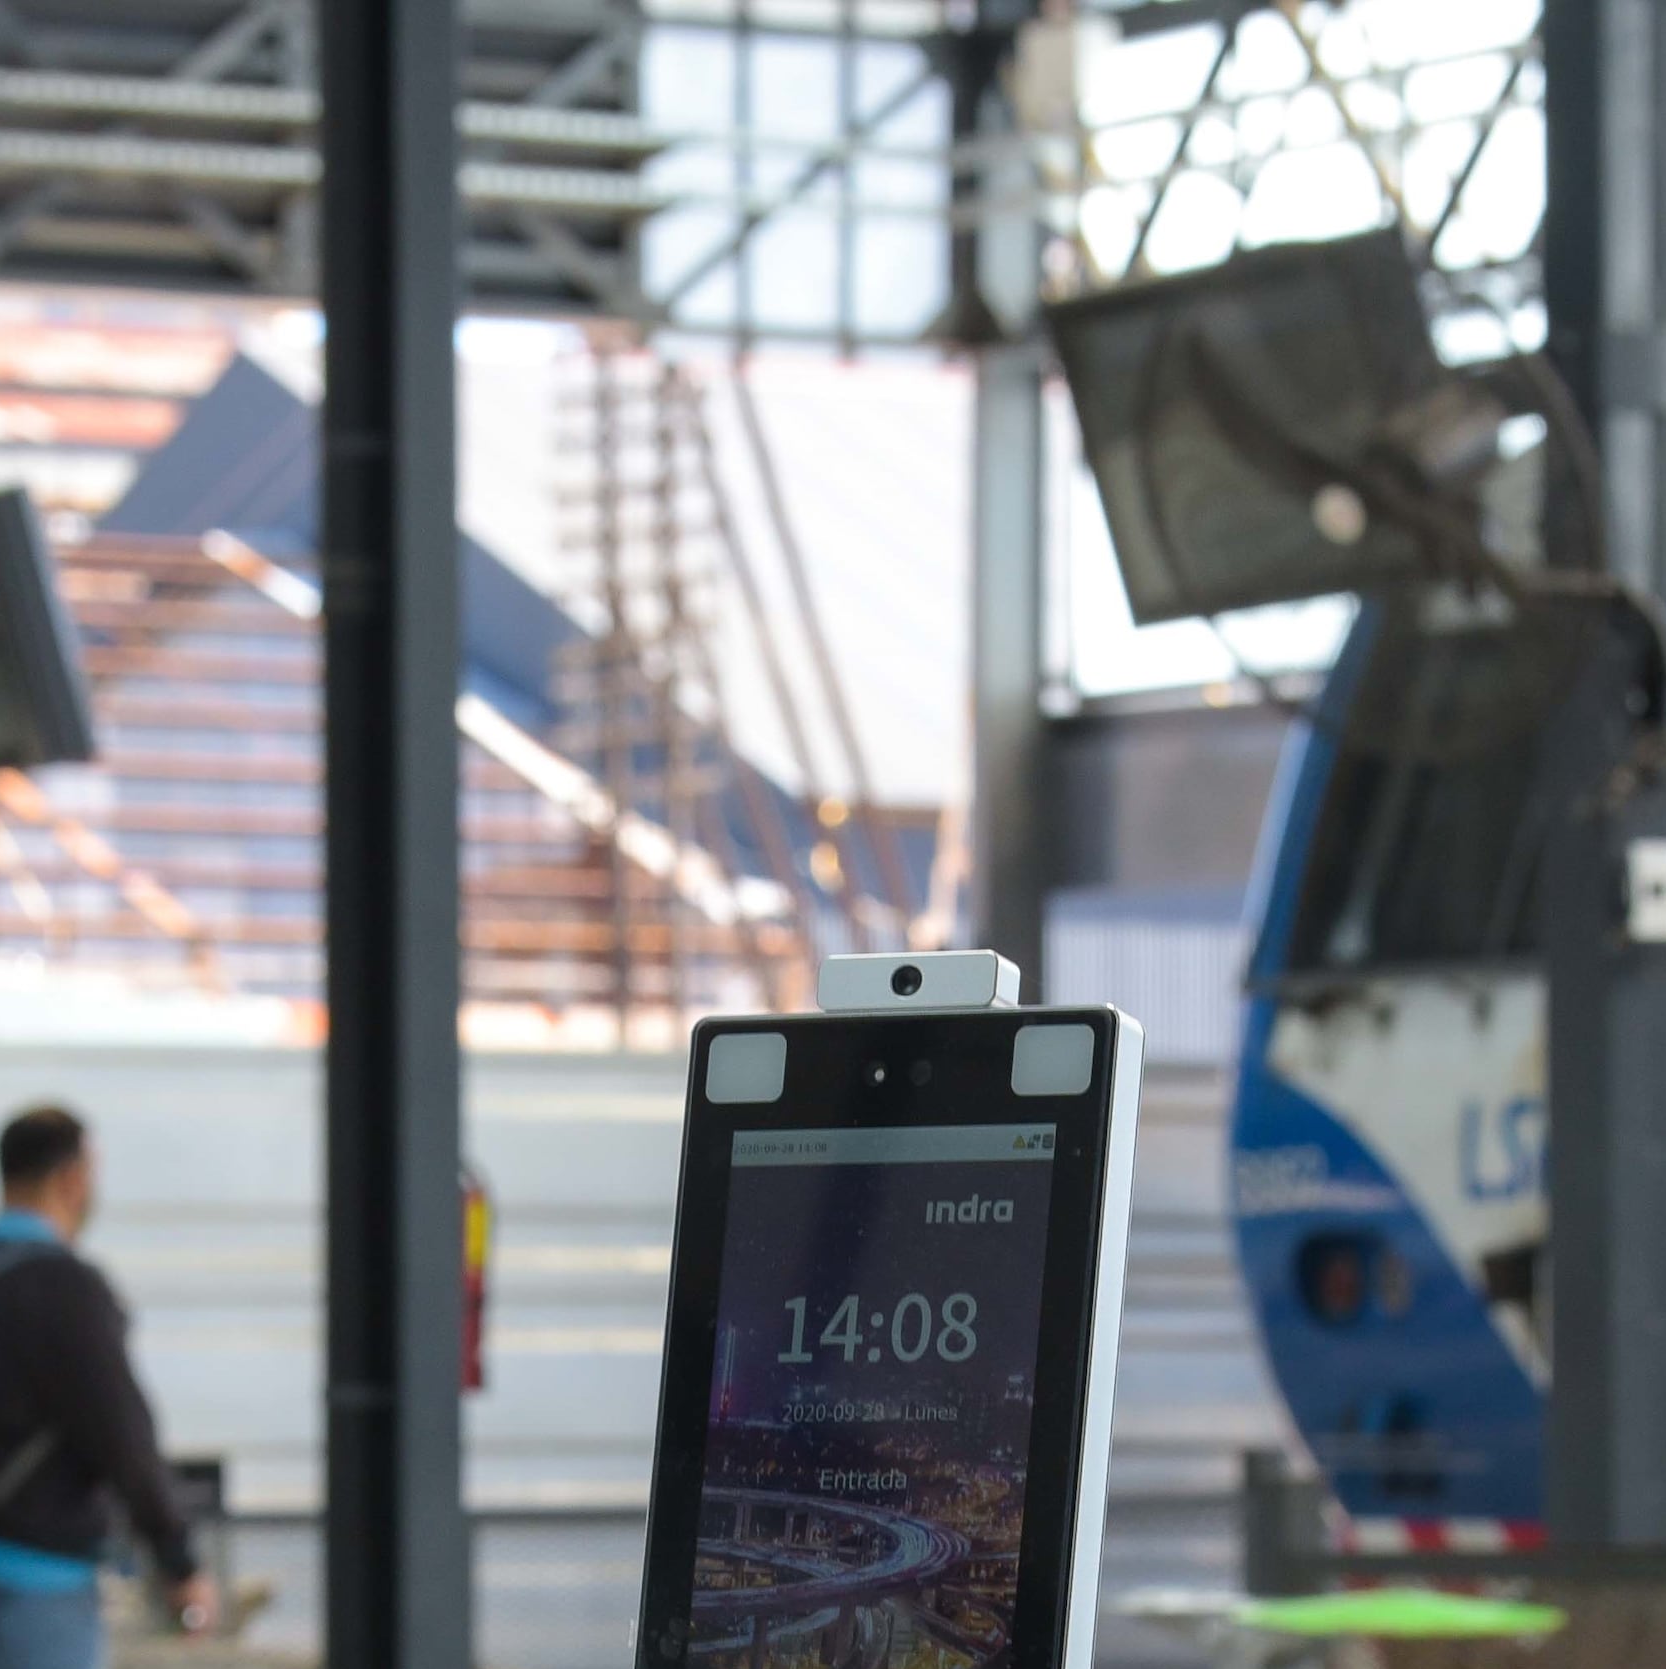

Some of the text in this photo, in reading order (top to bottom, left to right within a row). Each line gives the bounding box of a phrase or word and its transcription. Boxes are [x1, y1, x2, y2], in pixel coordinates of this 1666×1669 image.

[925, 1193, 1014, 1224] indra
[777, 1292, 978, 1363] 14:08
[783, 1403, 884, 1422] 2020-09-28
[905, 1403, 958, 1422] Lunes
[819, 1468, 907, 1491] Entrada
